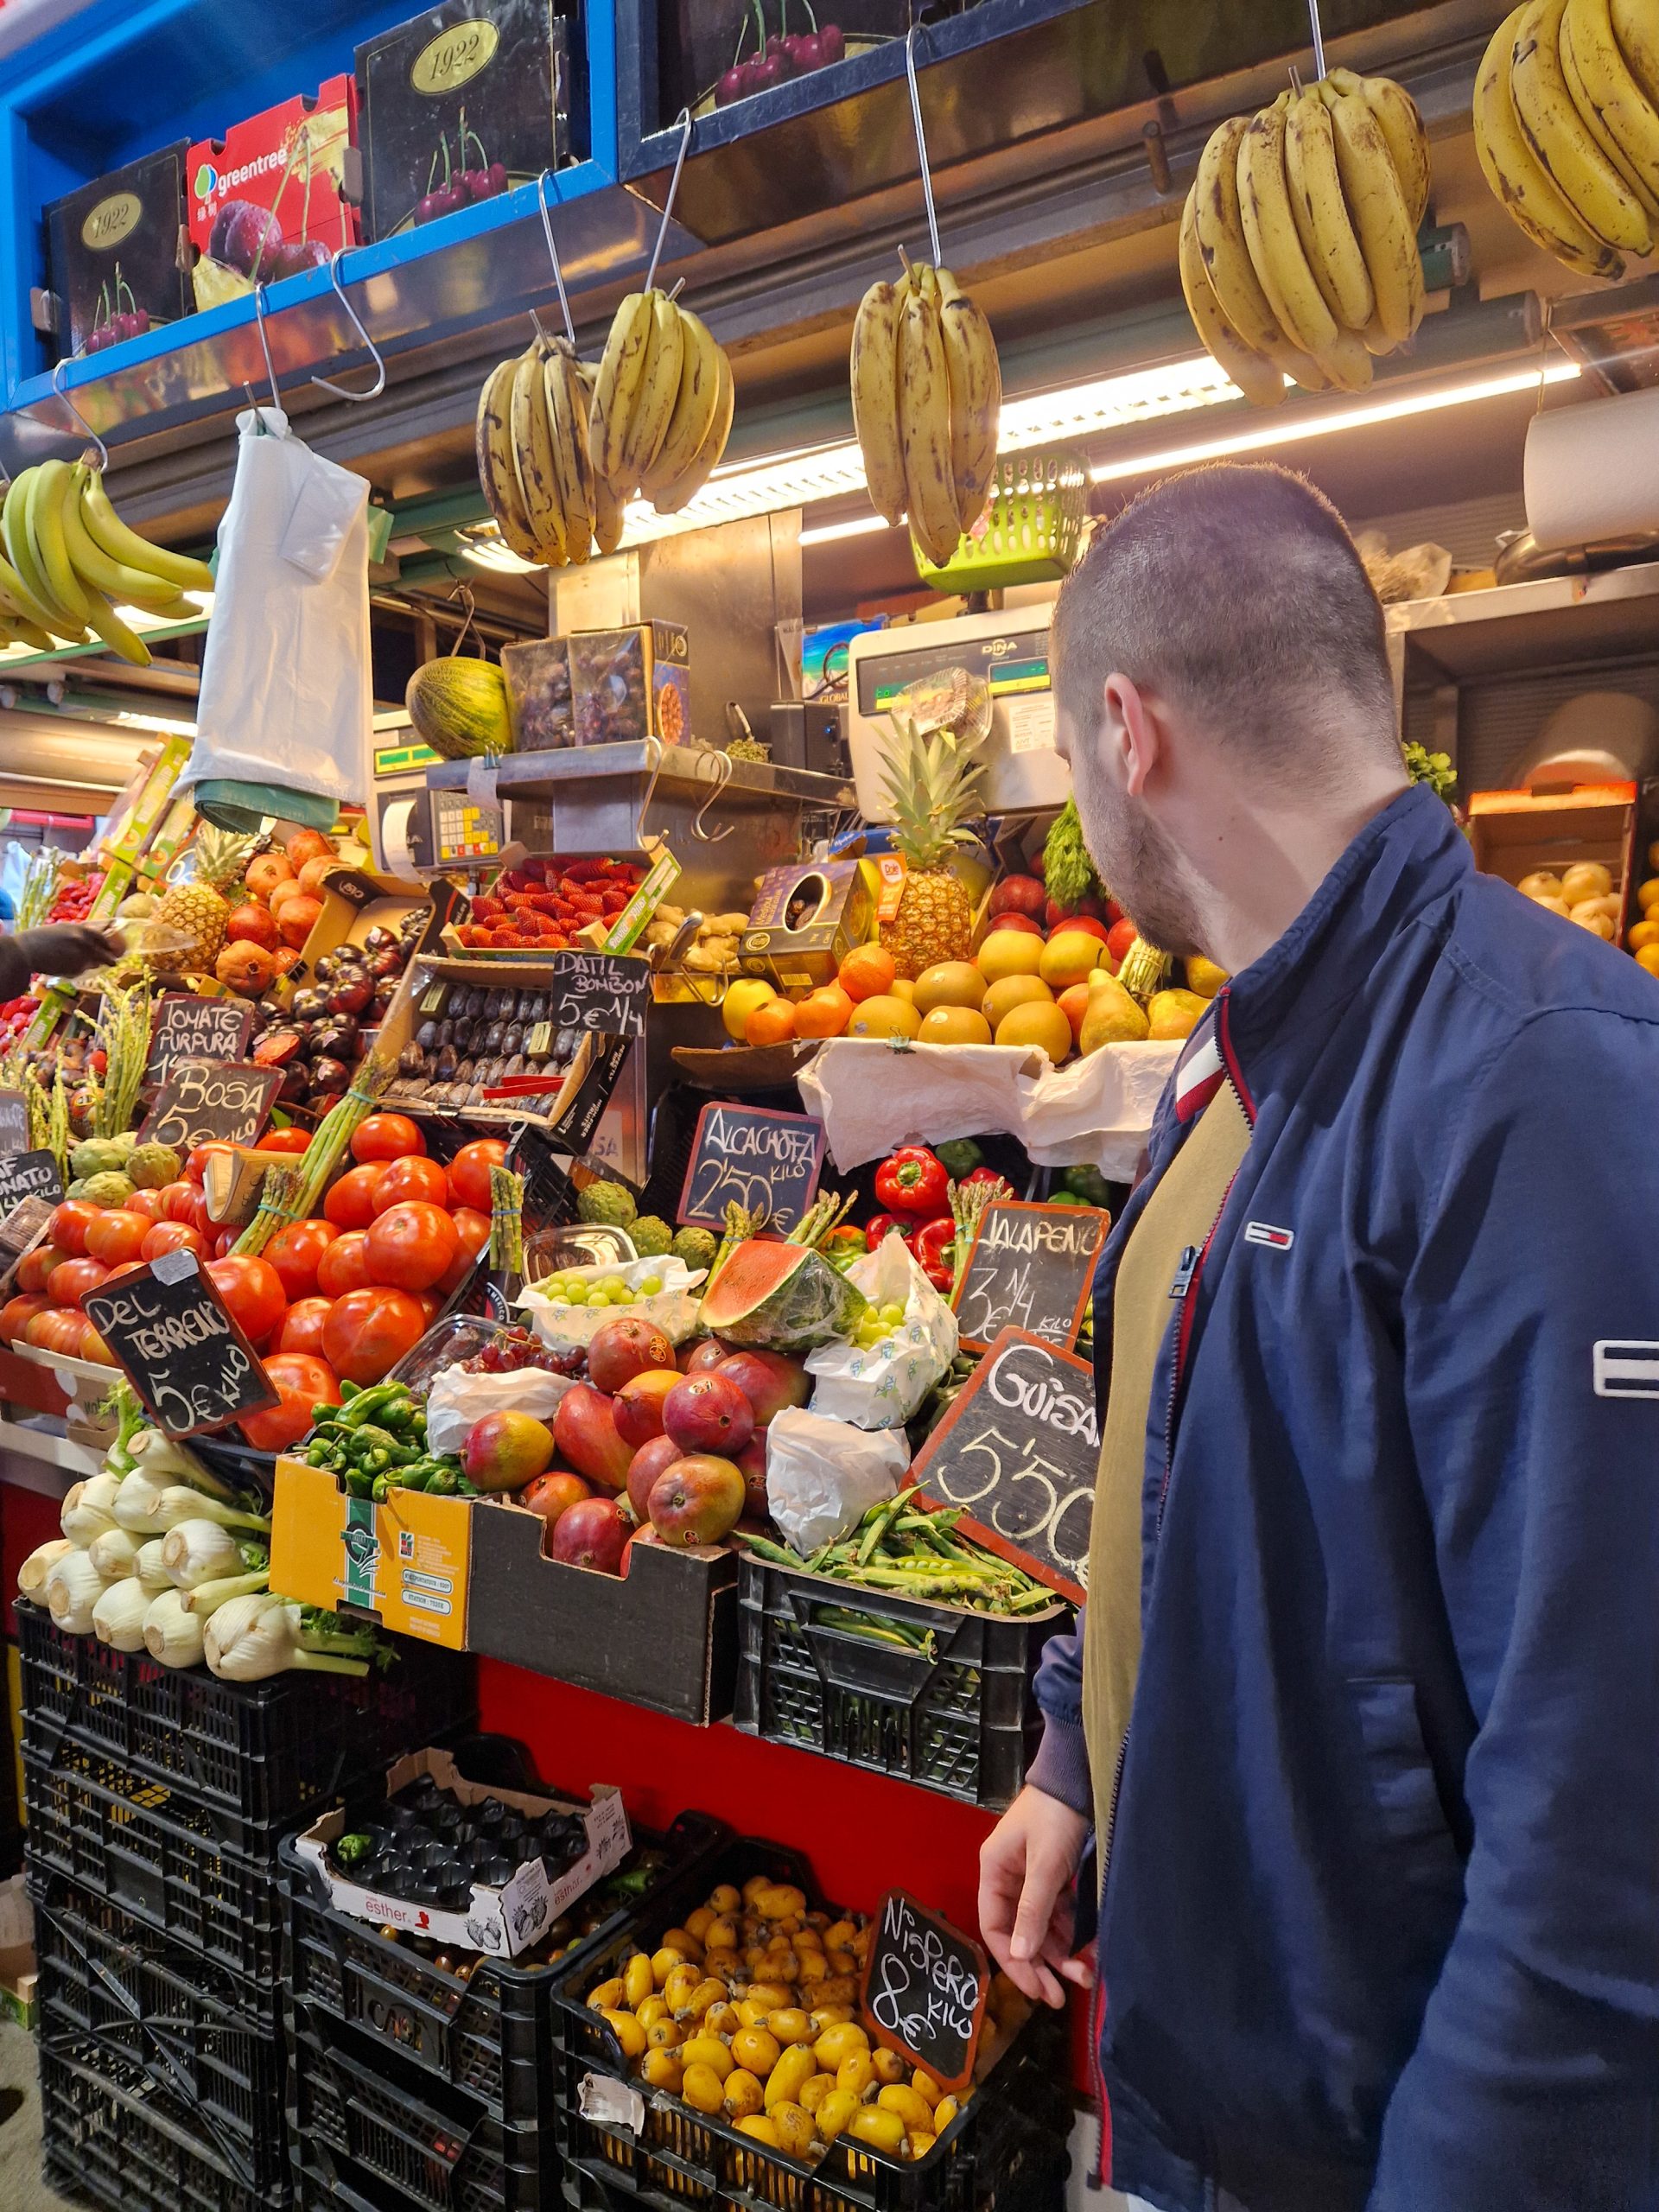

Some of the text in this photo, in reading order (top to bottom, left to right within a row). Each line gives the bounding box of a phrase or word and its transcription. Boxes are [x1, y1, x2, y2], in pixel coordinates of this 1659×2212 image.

[429, 34, 480, 81] 1922
[218, 148, 288, 198] greentree
[93, 203, 130, 239] 1922
[571, 969, 650, 995] BOMBON
[164, 999, 244, 1032] TOMATE
[156, 1027, 239, 1055] PURPURA
[705, 1107, 817, 1169] ALCACHOFA
[770, 1160, 806, 1184] KILO
[1039, 1314, 1072, 1331] KILO
[213, 1344, 251, 1410] KILO
[988, 1344, 1101, 1447] GUISA
[365, 1901, 407, 1923] esther
[927, 1992, 973, 2040] KILO
